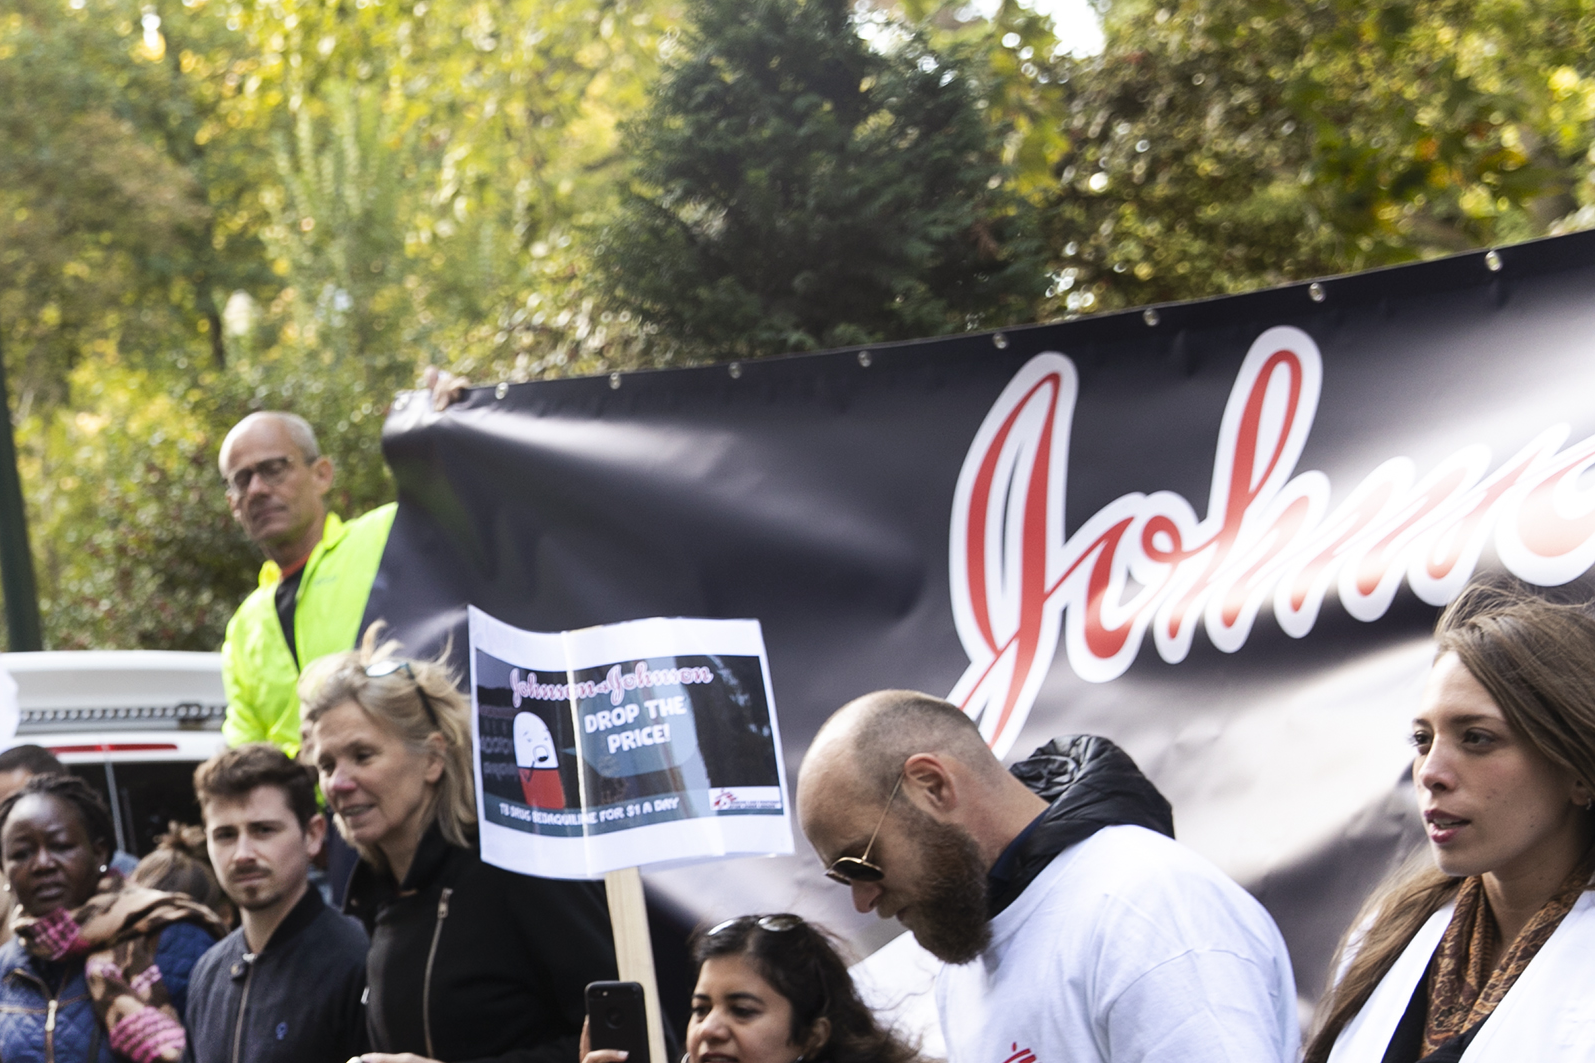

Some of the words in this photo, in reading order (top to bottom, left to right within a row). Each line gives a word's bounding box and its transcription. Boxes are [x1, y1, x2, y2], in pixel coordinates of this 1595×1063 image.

[584, 703, 640, 733] DROP
[644, 695, 687, 720] THE
[607, 723, 671, 754] PRICE!
[599, 807, 625, 822] FOR
[642, 801, 653, 814] A
[653, 797, 680, 812] DAY
